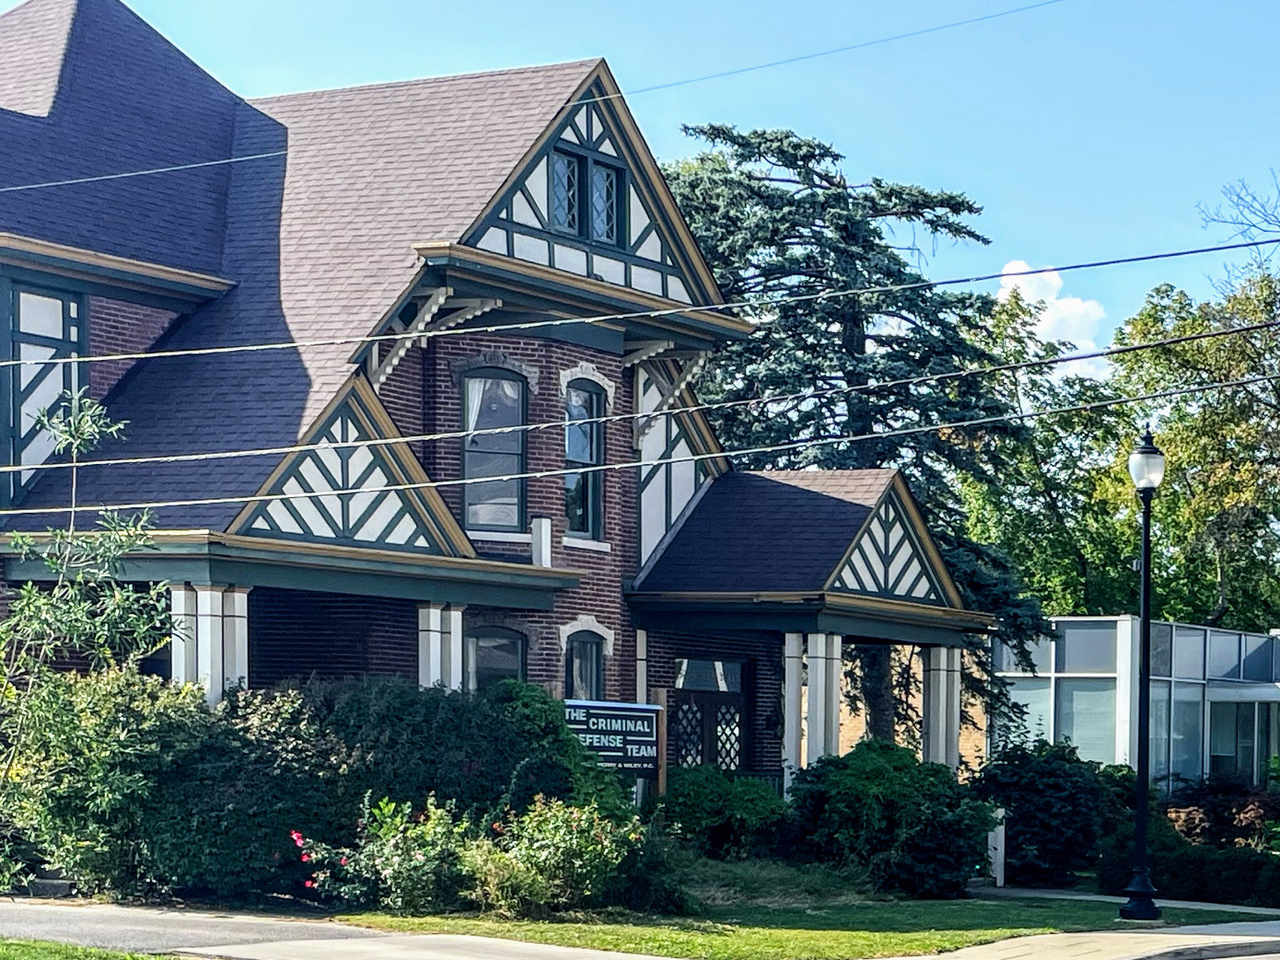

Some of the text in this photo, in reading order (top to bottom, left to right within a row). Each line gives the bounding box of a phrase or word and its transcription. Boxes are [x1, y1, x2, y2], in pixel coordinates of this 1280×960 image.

[565, 708, 587, 721] THE
[589, 718, 651, 732] CRIMINAL
[573, 733, 624, 748] EFENSE
[626, 745, 657, 757] TEAM
